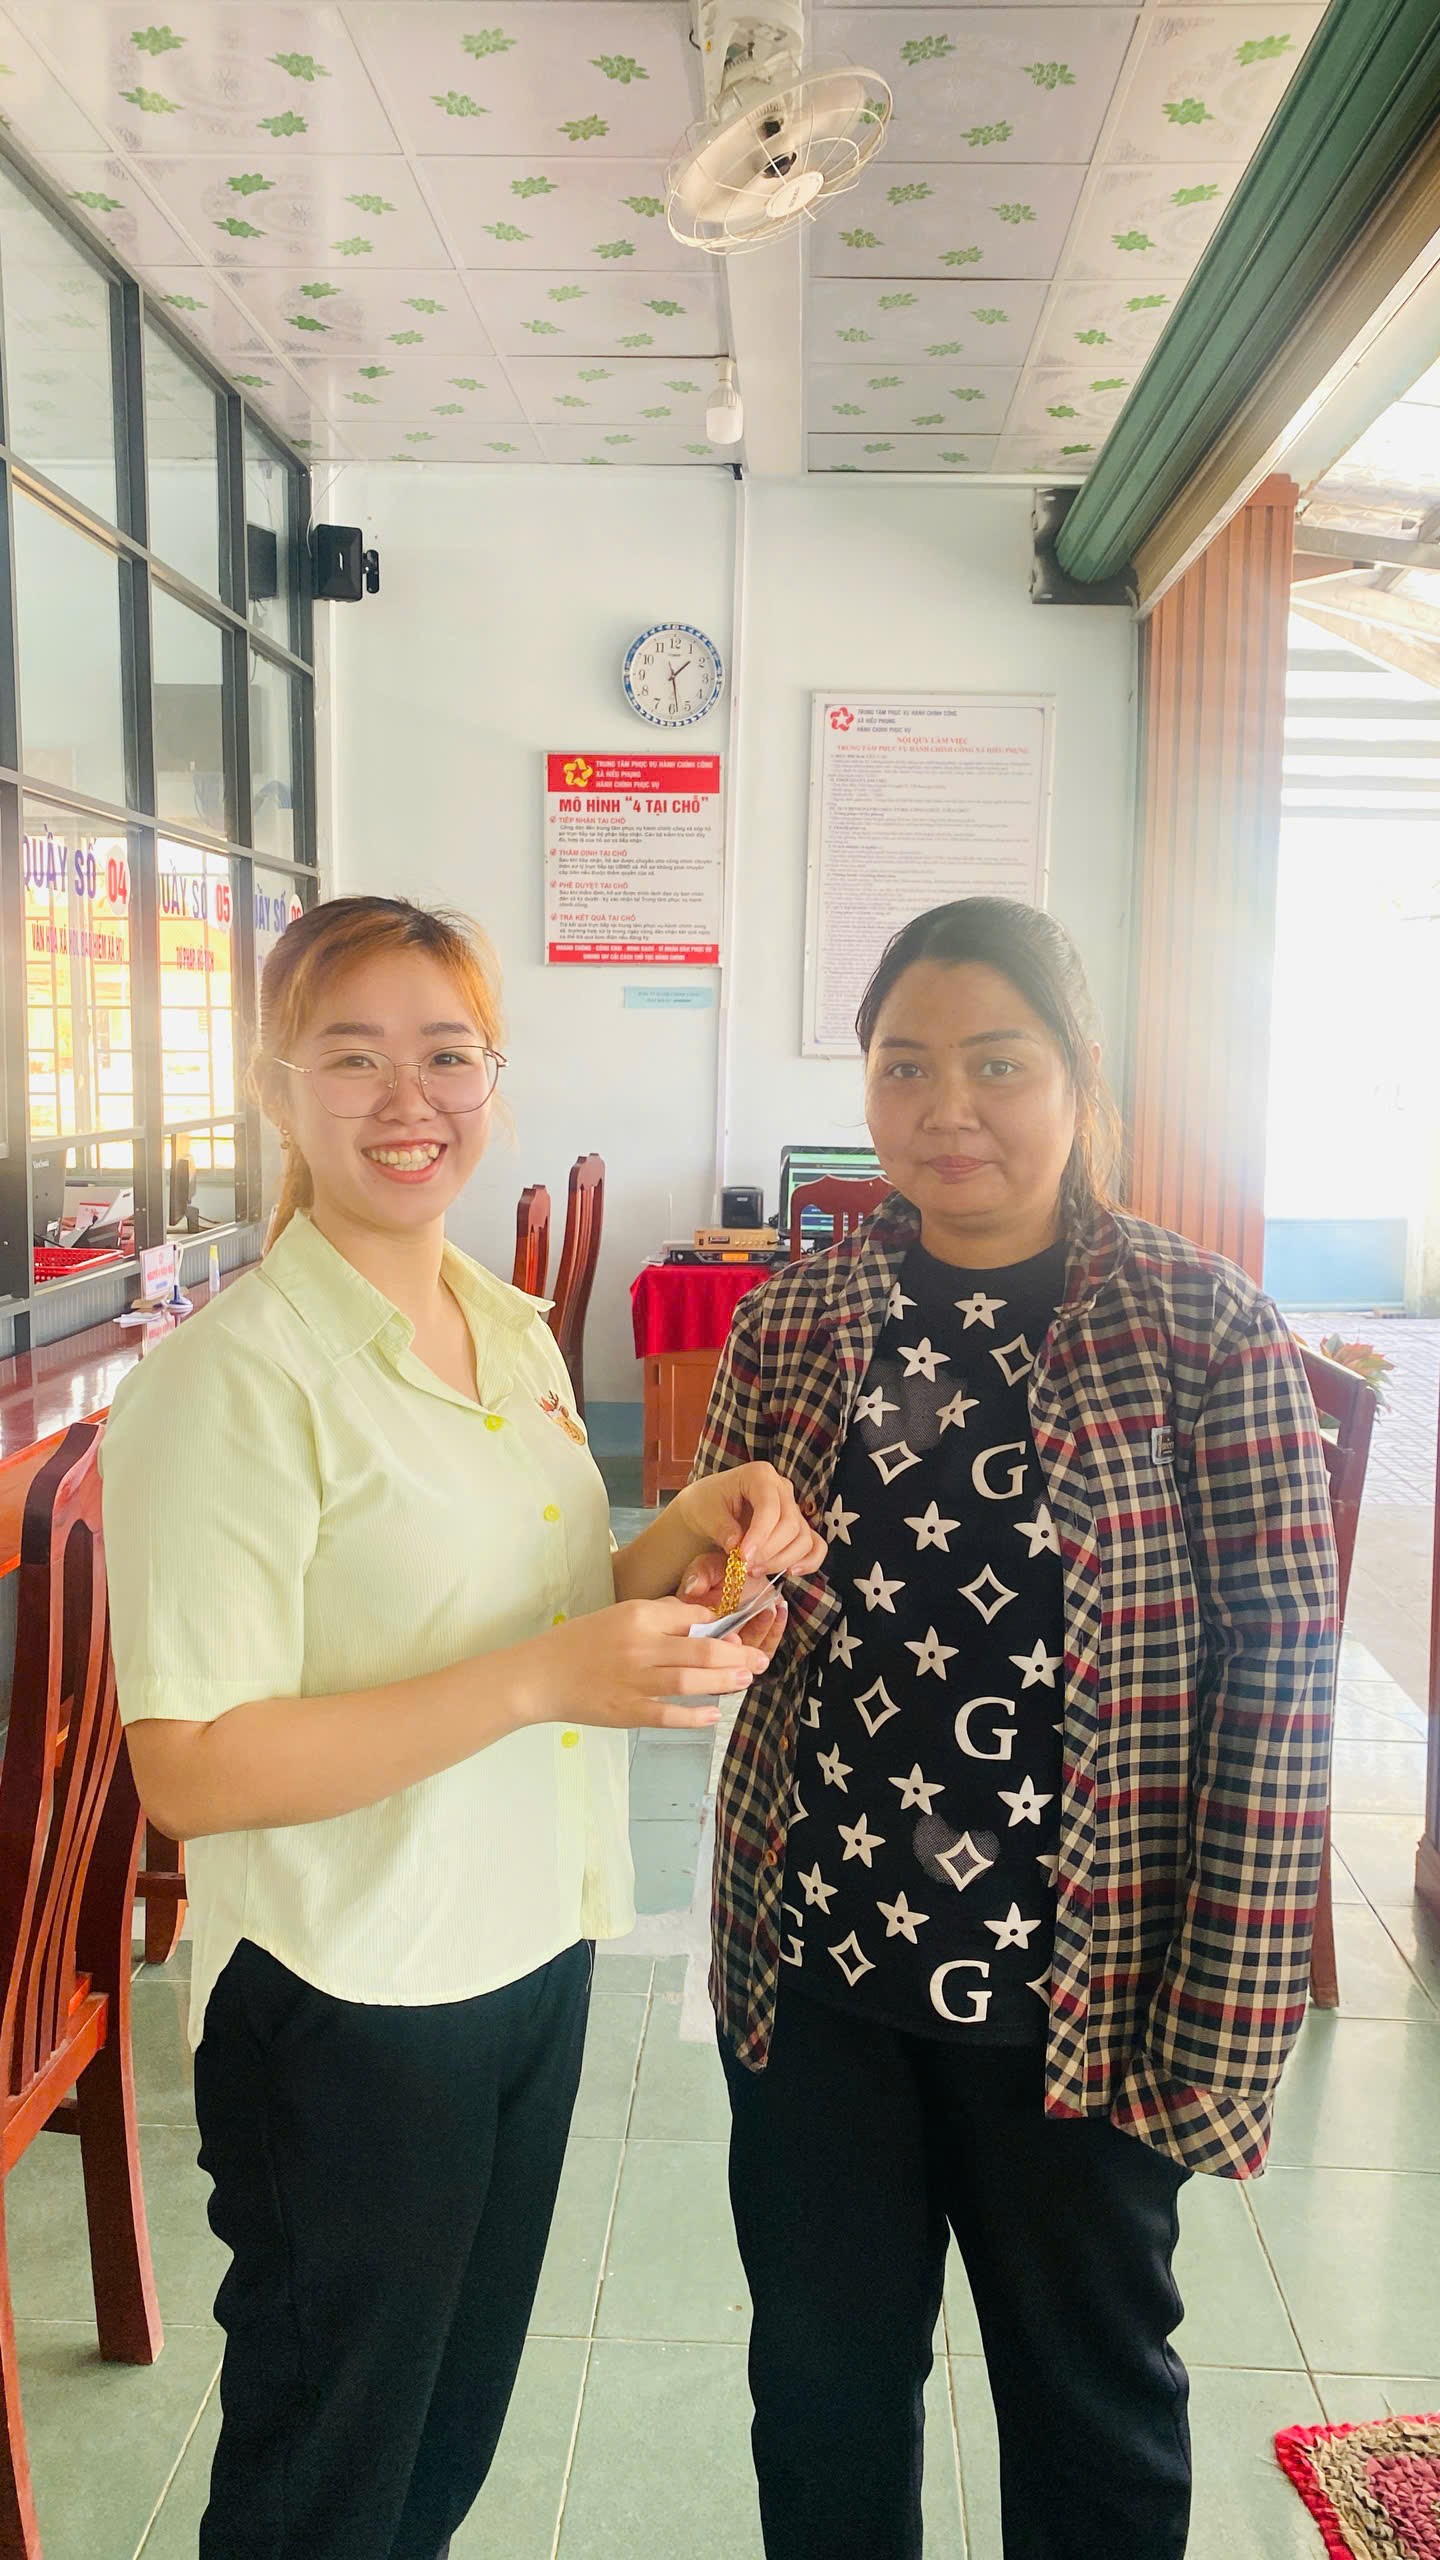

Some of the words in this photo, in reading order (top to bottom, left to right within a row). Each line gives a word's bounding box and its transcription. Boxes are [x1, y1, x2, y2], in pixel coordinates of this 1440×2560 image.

[656, 642, 664, 653] 11
[670, 638, 681, 649] 12
[643, 655, 654, 665] 10
[698, 657, 706, 668] 2
[638, 669, 646, 680] 9
[703, 673, 709, 684] 3
[641, 685, 649, 696] 8
[696, 688, 703, 699] 4
[653, 697, 661, 709] 7
[668, 703, 676, 714] 6
[684, 700, 691, 711] 5
[559, 795, 582, 813] MÔ
[586, 795, 620, 813] HÌNH
[646, 799, 668, 816] TẠI
[75, 838, 97, 899] SỐ
[107, 857, 127, 905] 04
[160, 858, 186, 916] UẦY
[216, 883, 230, 923] 05
[971, 1440, 1028, 1500] G
[954, 1696, 1018, 1760] G
[929, 1959, 992, 2023] G
